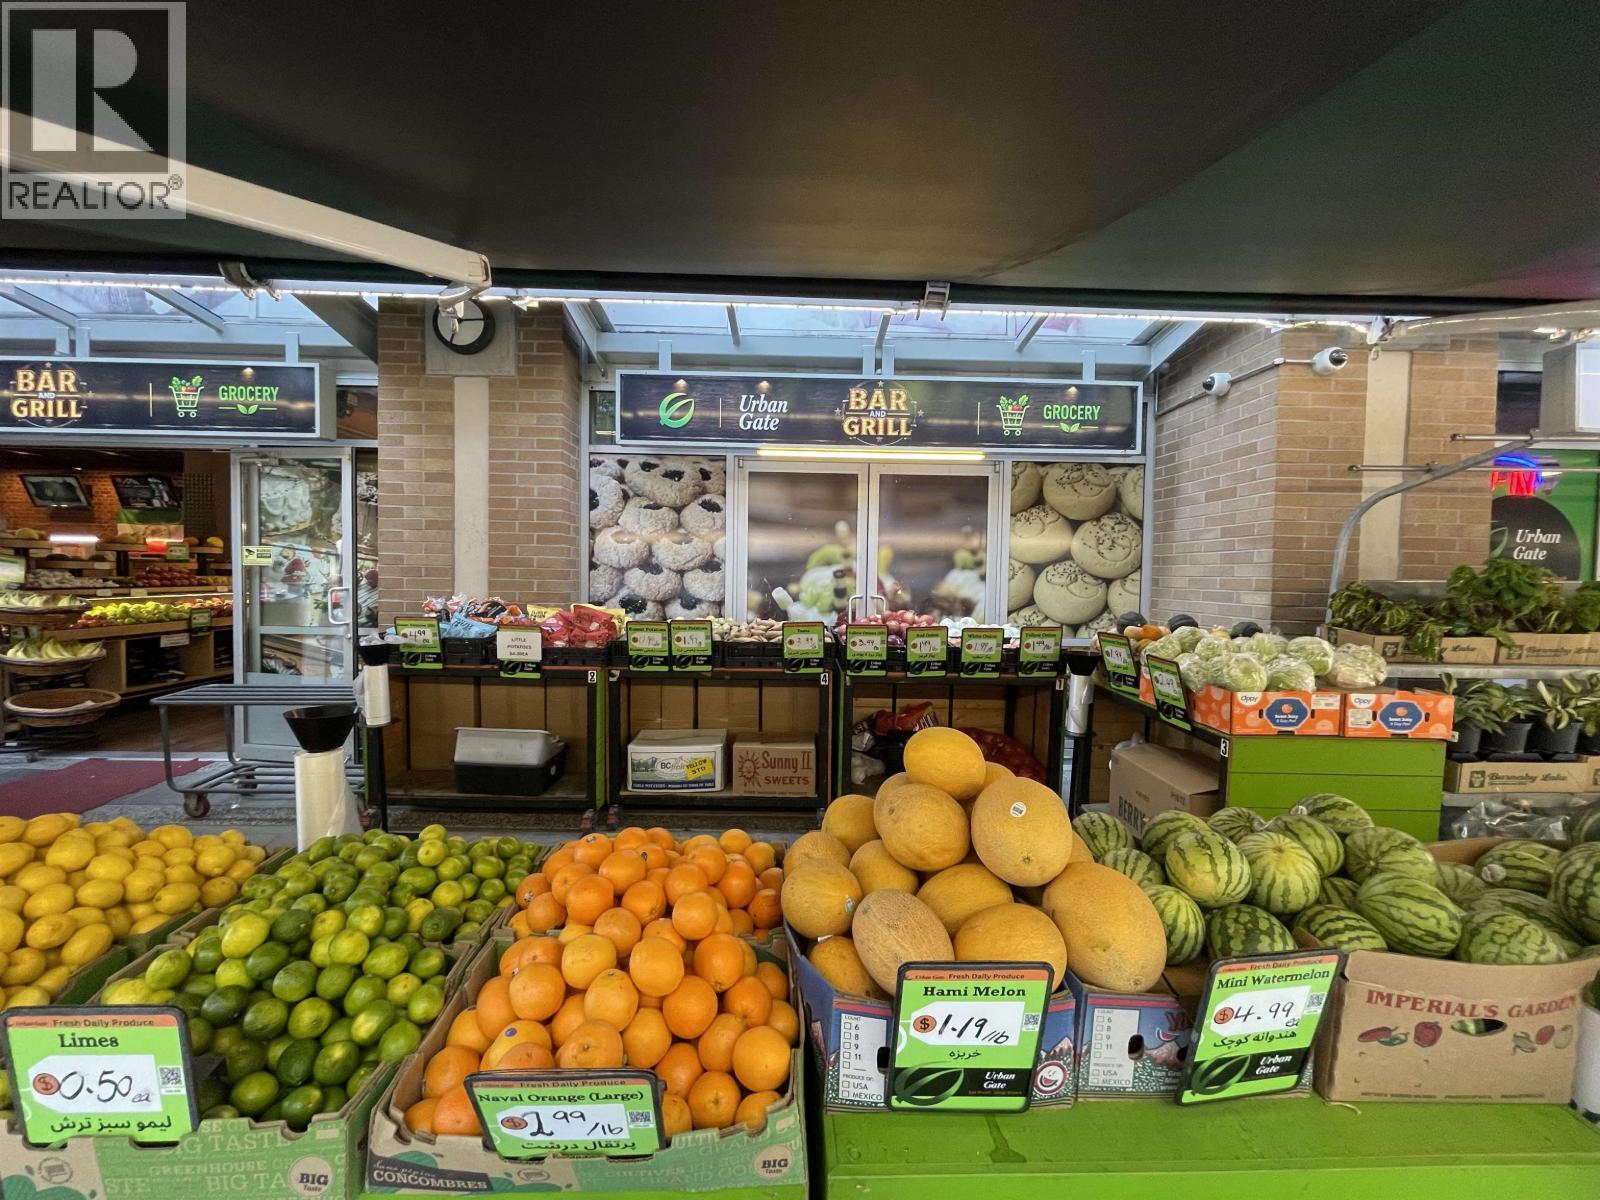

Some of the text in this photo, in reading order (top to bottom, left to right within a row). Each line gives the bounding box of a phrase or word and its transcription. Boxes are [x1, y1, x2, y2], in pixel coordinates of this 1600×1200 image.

[16, 369, 78, 392] BAR
[218, 385, 279, 401] GROCERY
[739, 394, 788, 413] Urban
[849, 388, 909, 411] BAR
[11, 398, 82, 418] GRILL
[869, 410, 887, 418] AND
[1043, 404, 1101, 421] GROCERY
[739, 413, 780, 430] Gate
[843, 416, 913, 436] GRILL
[1516, 528, 1561, 544] Urban
[1513, 545, 1548, 560] Gate
[822, 675, 828, 684] 4
[1240, 695, 1258, 703] Oppy
[1354, 697, 1371, 705] Oppy
[1222, 740, 1228, 756] 3
[686, 758, 707, 769] YELLOW
[762, 750, 798, 772] Sunny
[764, 776, 810, 785] SWEETS
[1249, 963, 1271, 971] Fresh
[972, 973, 991, 981] Daily
[1216, 976, 1248, 989] Mini
[1252, 969, 1330, 985] Watermelon
[923, 986, 1026, 997] Hami Melon
[1365, 988, 1499, 1018] IMPERIAL'S
[53, 1019, 83, 1027] Fresh
[84, 1019, 109, 1028] Daily
[854, 1023, 860, 1031] 6
[58, 1033, 119, 1048] Limes
[854, 1033, 859, 1041] 8
[1213, 1031, 1297, 1049] هندوانه کوچک
[1260, 1055, 1292, 1065] Urban
[985, 1071, 1016, 1080] Urban
[1255, 1065, 1281, 1075] Gate
[581, 1079, 625, 1087] Produce
[852, 1082, 868, 1090] USA
[983, 1080, 1007, 1089] Gate
[132, 1090, 152, 1103] ea
[478, 1091, 643, 1103] Naval Orange (Large)
[852, 1092, 882, 1101] MEXICO
[51, 1116, 92, 1132] ترش
[98, 1117, 131, 1132] سبز
[761, 1158, 788, 1169] BIG
[299, 1173, 328, 1186] BIG
[373, 1169, 488, 1189] CONCOMBRES
